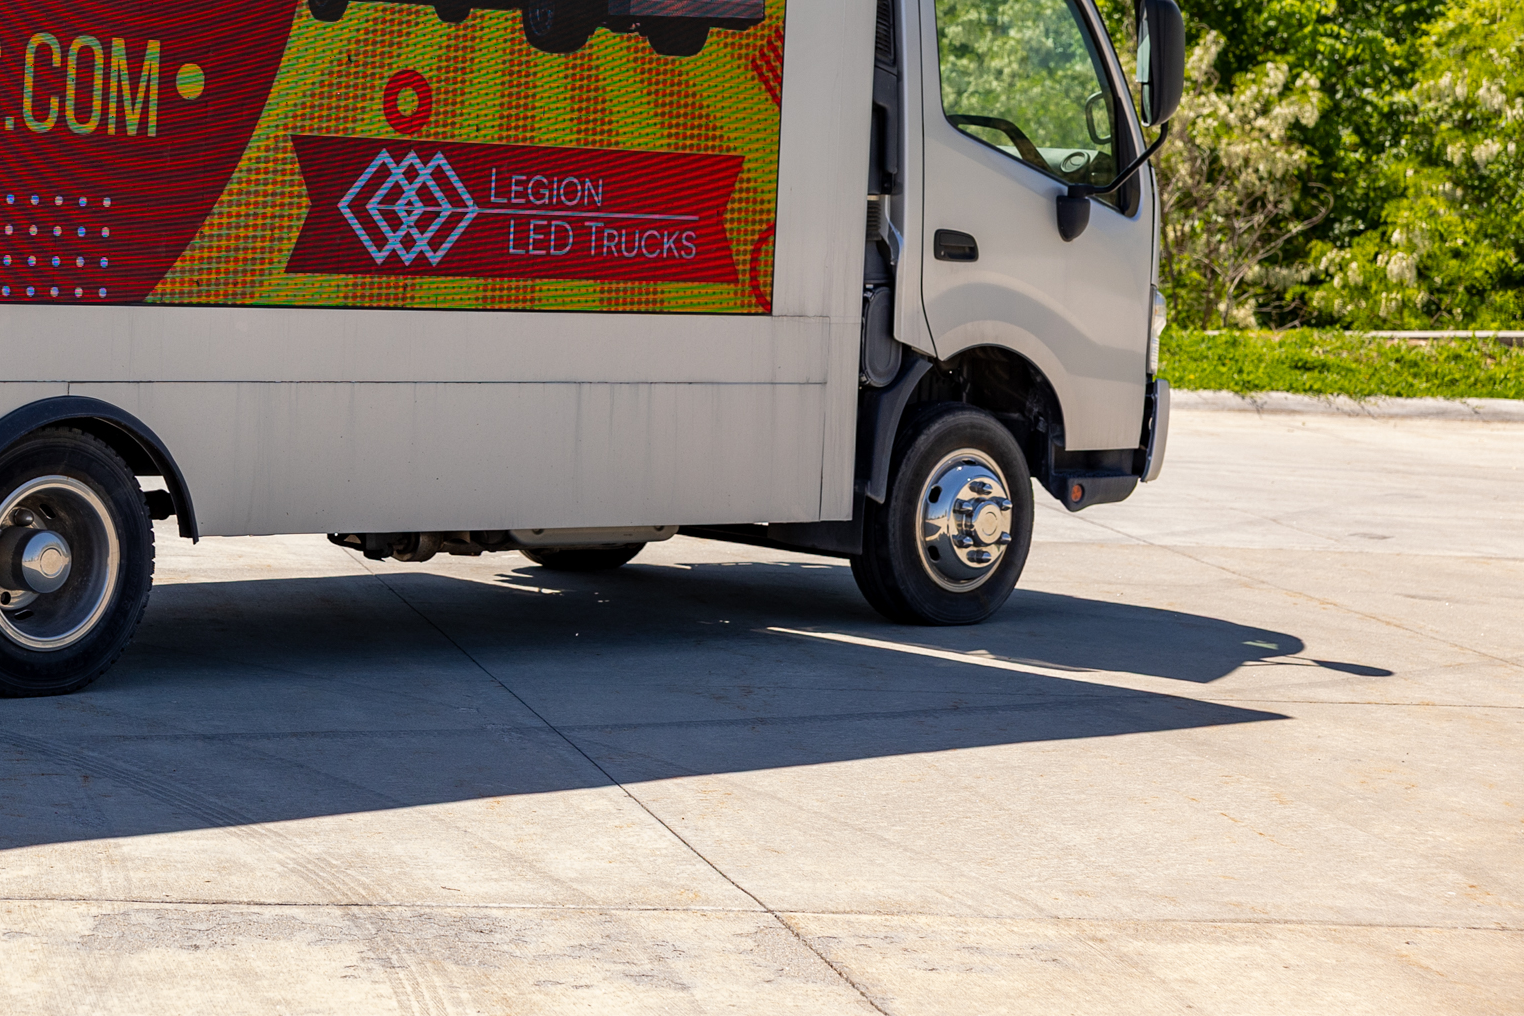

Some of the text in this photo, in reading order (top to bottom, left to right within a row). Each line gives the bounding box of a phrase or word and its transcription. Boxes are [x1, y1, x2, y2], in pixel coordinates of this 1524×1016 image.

[489, 166, 603, 207] LEGION
[508, 218, 697, 260] LED TRUCKS
